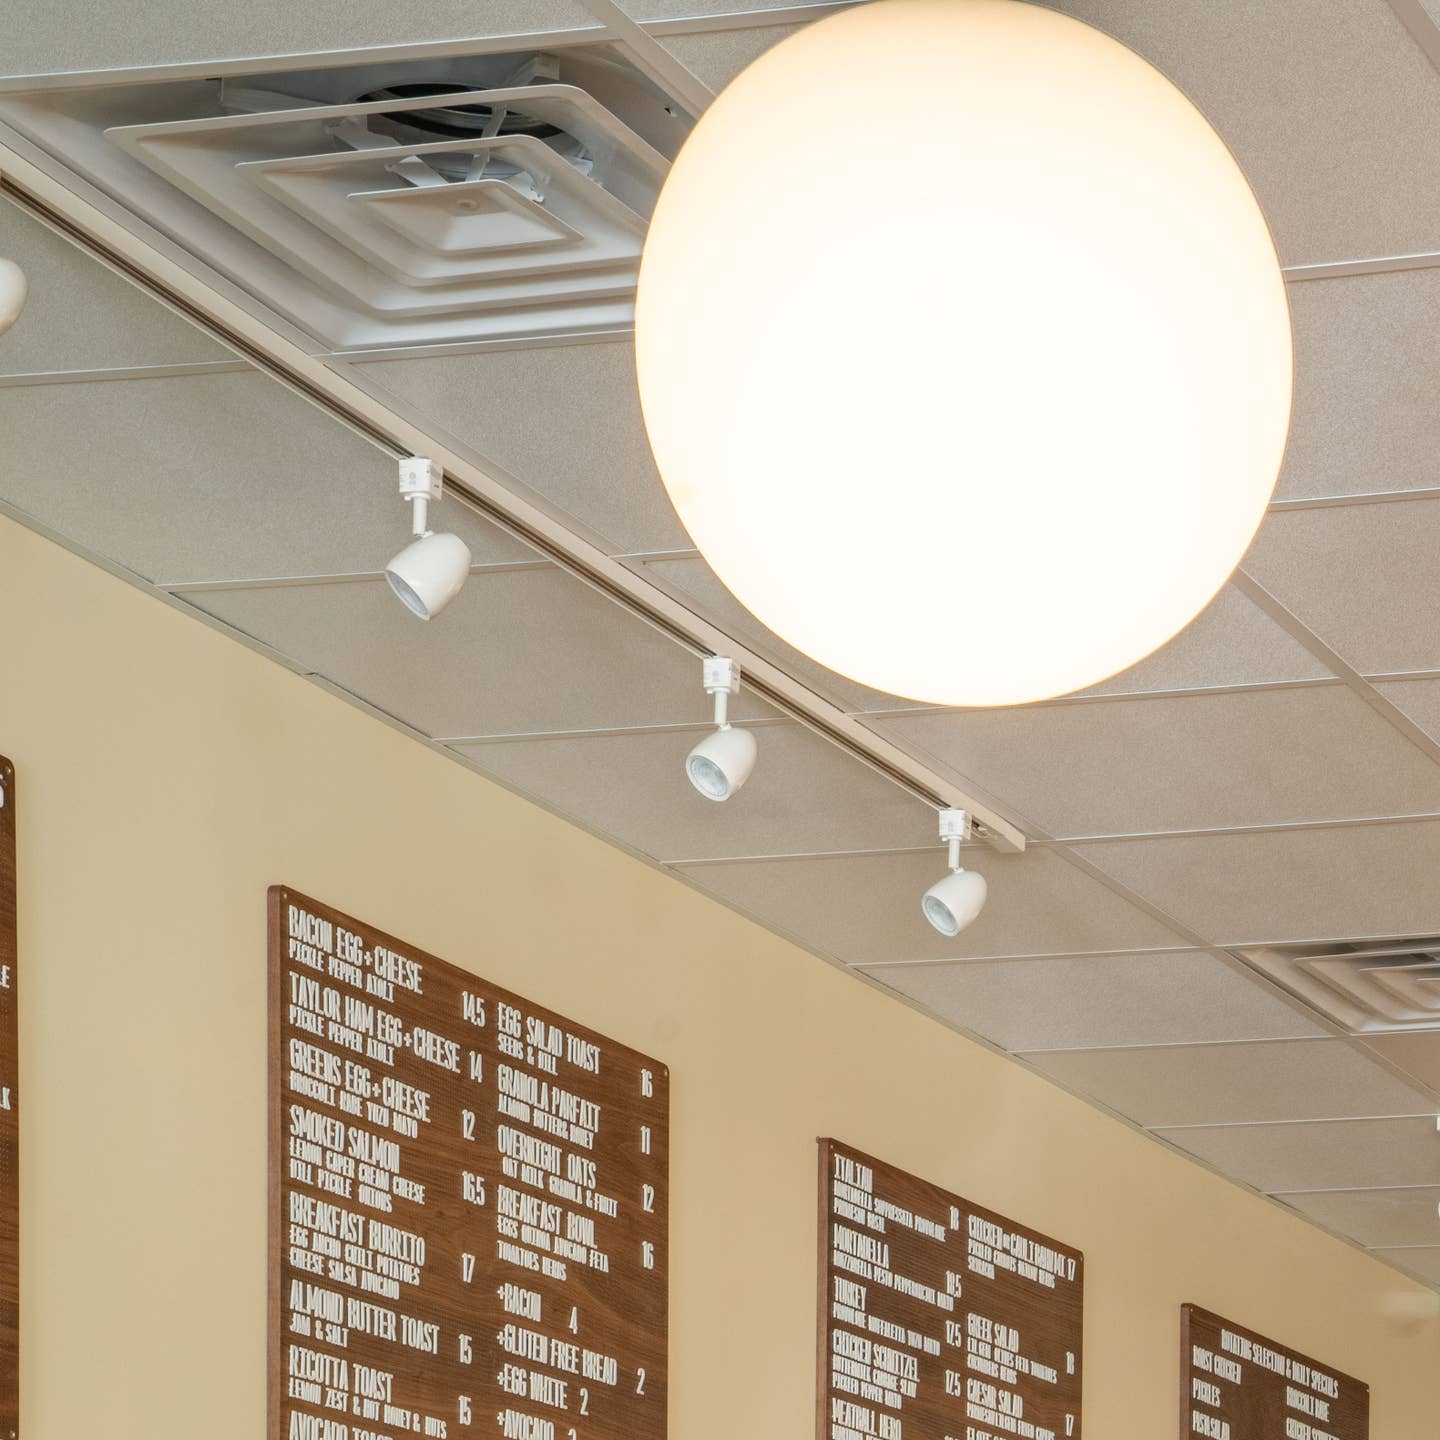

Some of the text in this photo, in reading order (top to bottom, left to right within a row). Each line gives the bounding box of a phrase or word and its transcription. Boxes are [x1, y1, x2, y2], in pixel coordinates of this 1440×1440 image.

[288, 904, 333, 954] BACON
[462, 990, 486, 1027] 14.5
[289, 938, 325, 972] PICKLE
[328, 955, 363, 989] PEPPER
[289, 970, 341, 1023] TAYLOR
[344, 995, 374, 1036] HAM
[469, 1050, 483, 1083] 14
[497, 1001, 653, 1098] EGG SALAD TOAST 16
[527, 1046, 535, 1065] &
[289, 1038, 342, 1086] GREENS
[462, 1109, 475, 1141] 12
[497, 1063, 651, 1155] GRANOLA PARFAIT 11
[289, 1104, 486, 1206] SMOKED SALMON 16.5
[497, 1124, 655, 1213] OVERNIGHT OATS 12
[834, 1153, 873, 1194] ITALIAN
[392, 1175, 426, 1205] CHEESE
[289, 1191, 475, 1283] BREAKFAST BURRITO 17
[497, 1184, 654, 1270] BREAKFAST BOWL 16
[289, 1246, 400, 1300] CHEESE SALSA AVOCADO
[834, 1275, 867, 1312] TURKEY
[289, 1279, 472, 1365] ALMOND BUTTER TOAST 15
[289, 1312, 349, 1348] JAM & SALT
[568, 1306, 578, 1335] 4
[994, 1323, 1019, 1353] SALAD
[288, 1344, 472, 1426] RICOTTA TOAST 15
[529, 1371, 568, 1410] WHITE
[579, 1388, 589, 1416] 2
[550, 1338, 580, 1374] FREE
[582, 1348, 617, 1386] BREAD
[636, 1367, 646, 1395] 2
[325, 1387, 349, 1412] ZEST
[352, 1396, 361, 1416] &
[412, 1413, 421, 1433] &
[998, 1389, 1023, 1419] SALAD
[1065, 1413, 1074, 1437] 17
